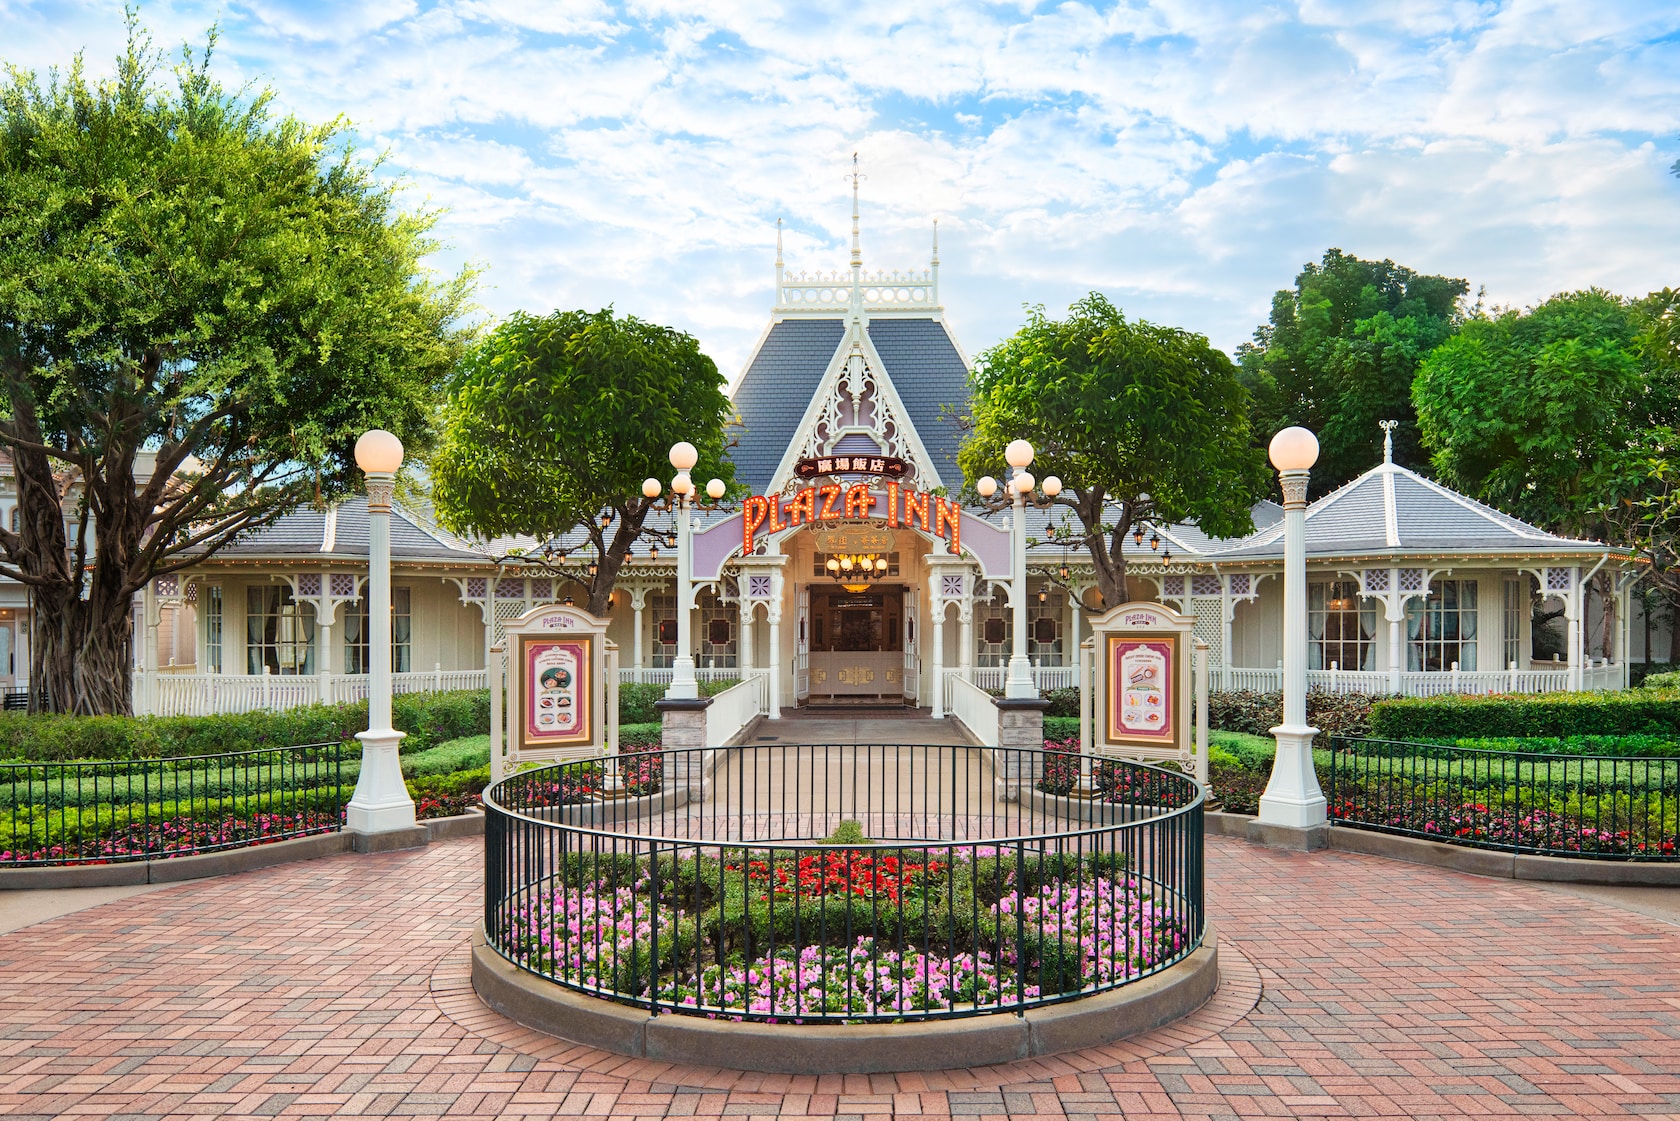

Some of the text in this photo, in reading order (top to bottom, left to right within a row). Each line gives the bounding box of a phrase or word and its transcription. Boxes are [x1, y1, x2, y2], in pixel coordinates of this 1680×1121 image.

[817, 457, 886, 473] 廣場飯店
[742, 481, 961, 557] PLAZA INN
